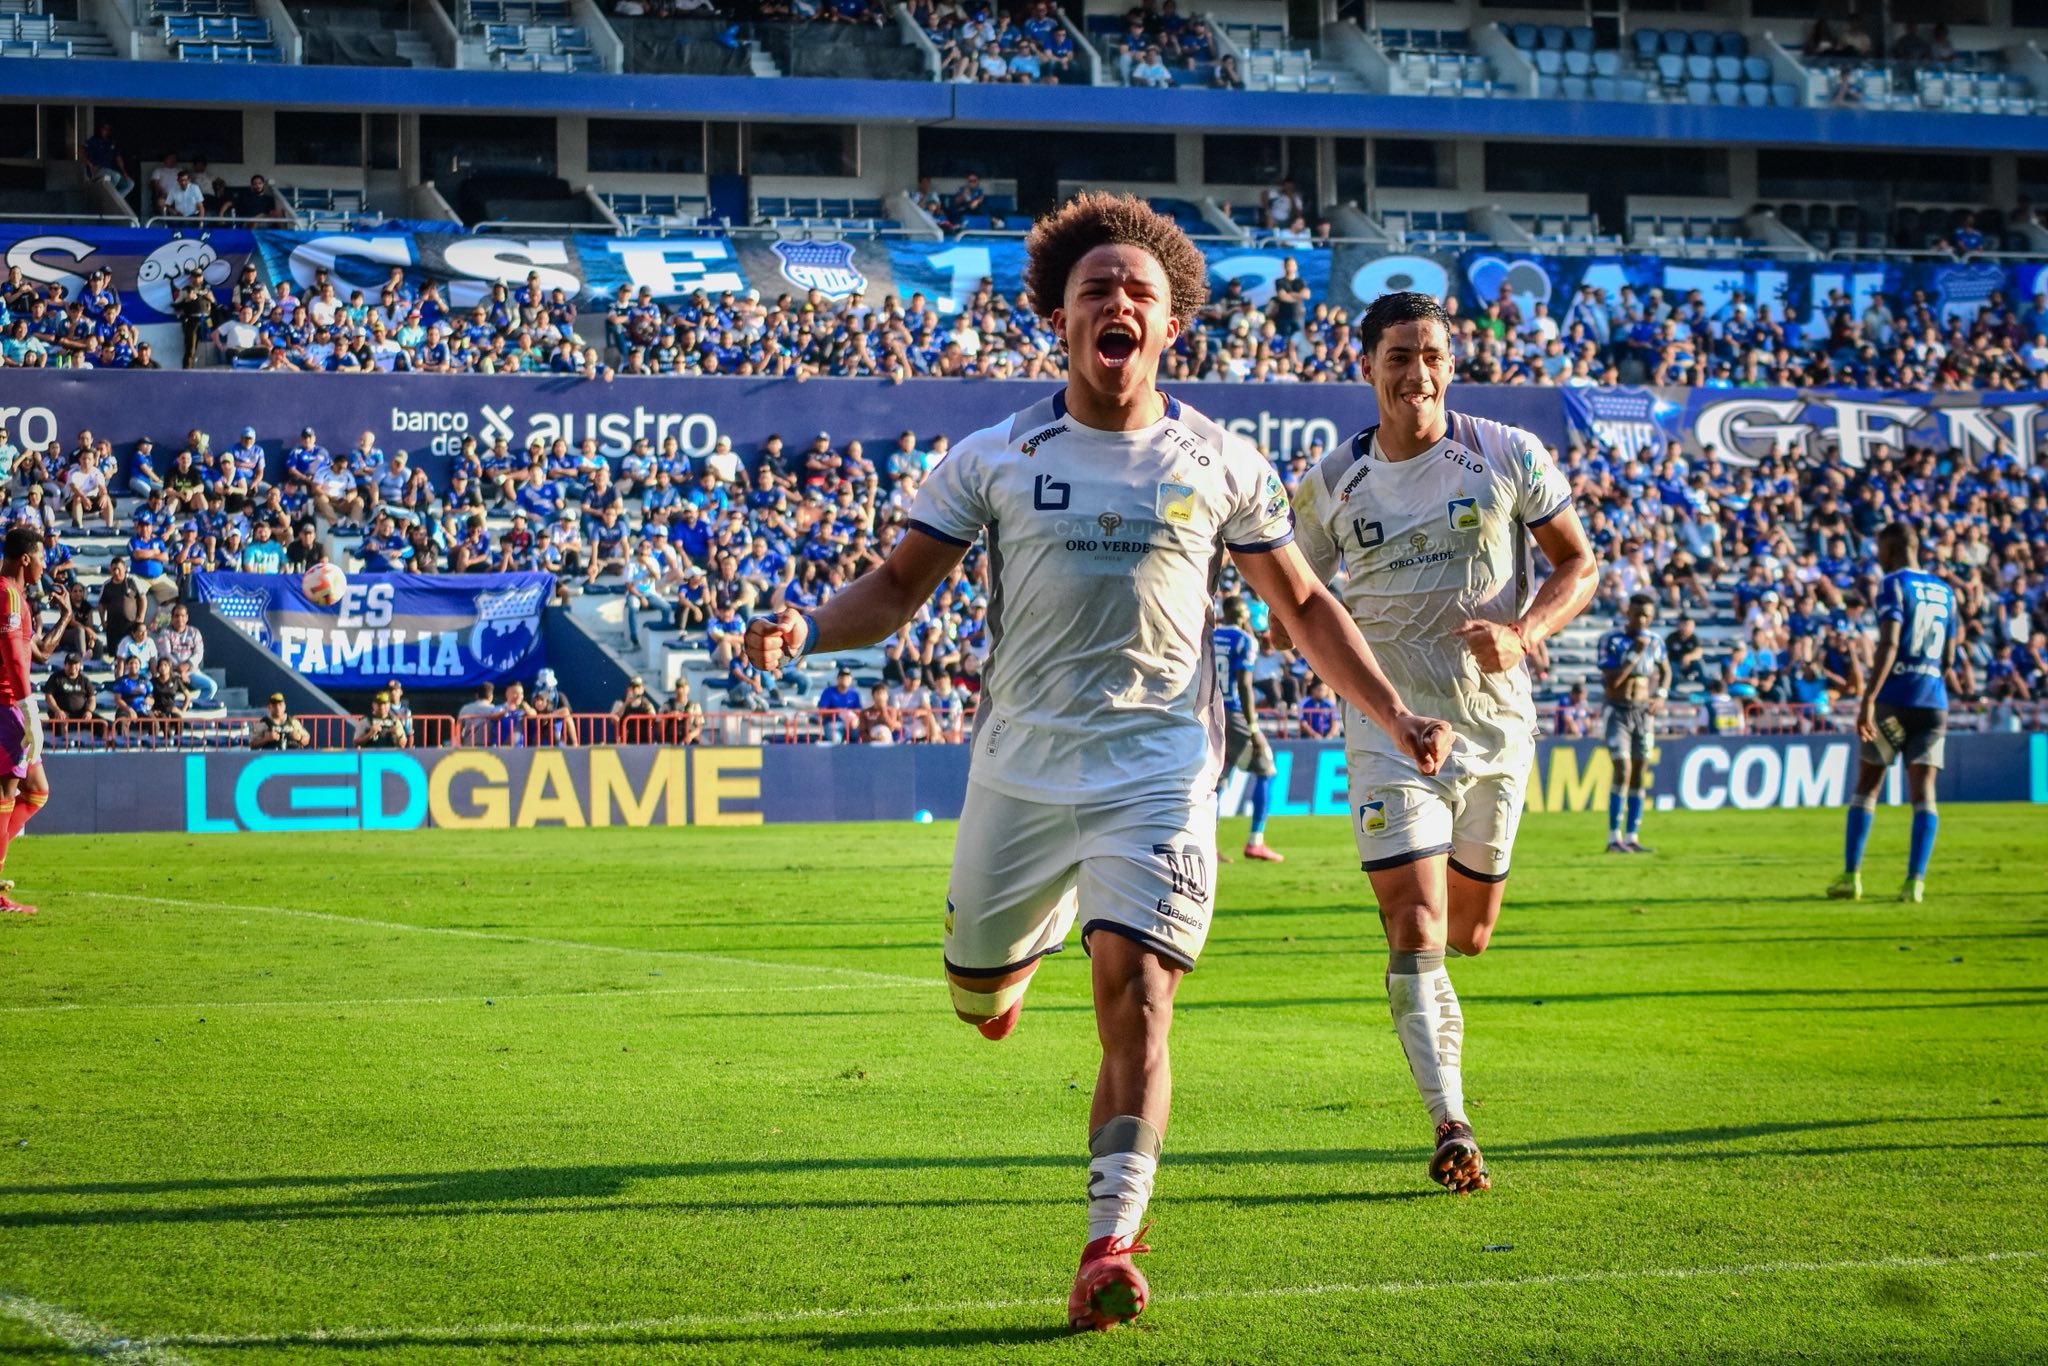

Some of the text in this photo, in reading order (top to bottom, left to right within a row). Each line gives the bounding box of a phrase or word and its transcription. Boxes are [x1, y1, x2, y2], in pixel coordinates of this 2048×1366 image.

[391, 407, 469, 432] banco
[525, 406, 718, 459] austro
[1065, 540, 1151, 554] ORO VERDE
[1389, 551, 1455, 570] ORO VERDE
[336, 583, 395, 628] ES
[279, 627, 465, 676] FAMILIA
